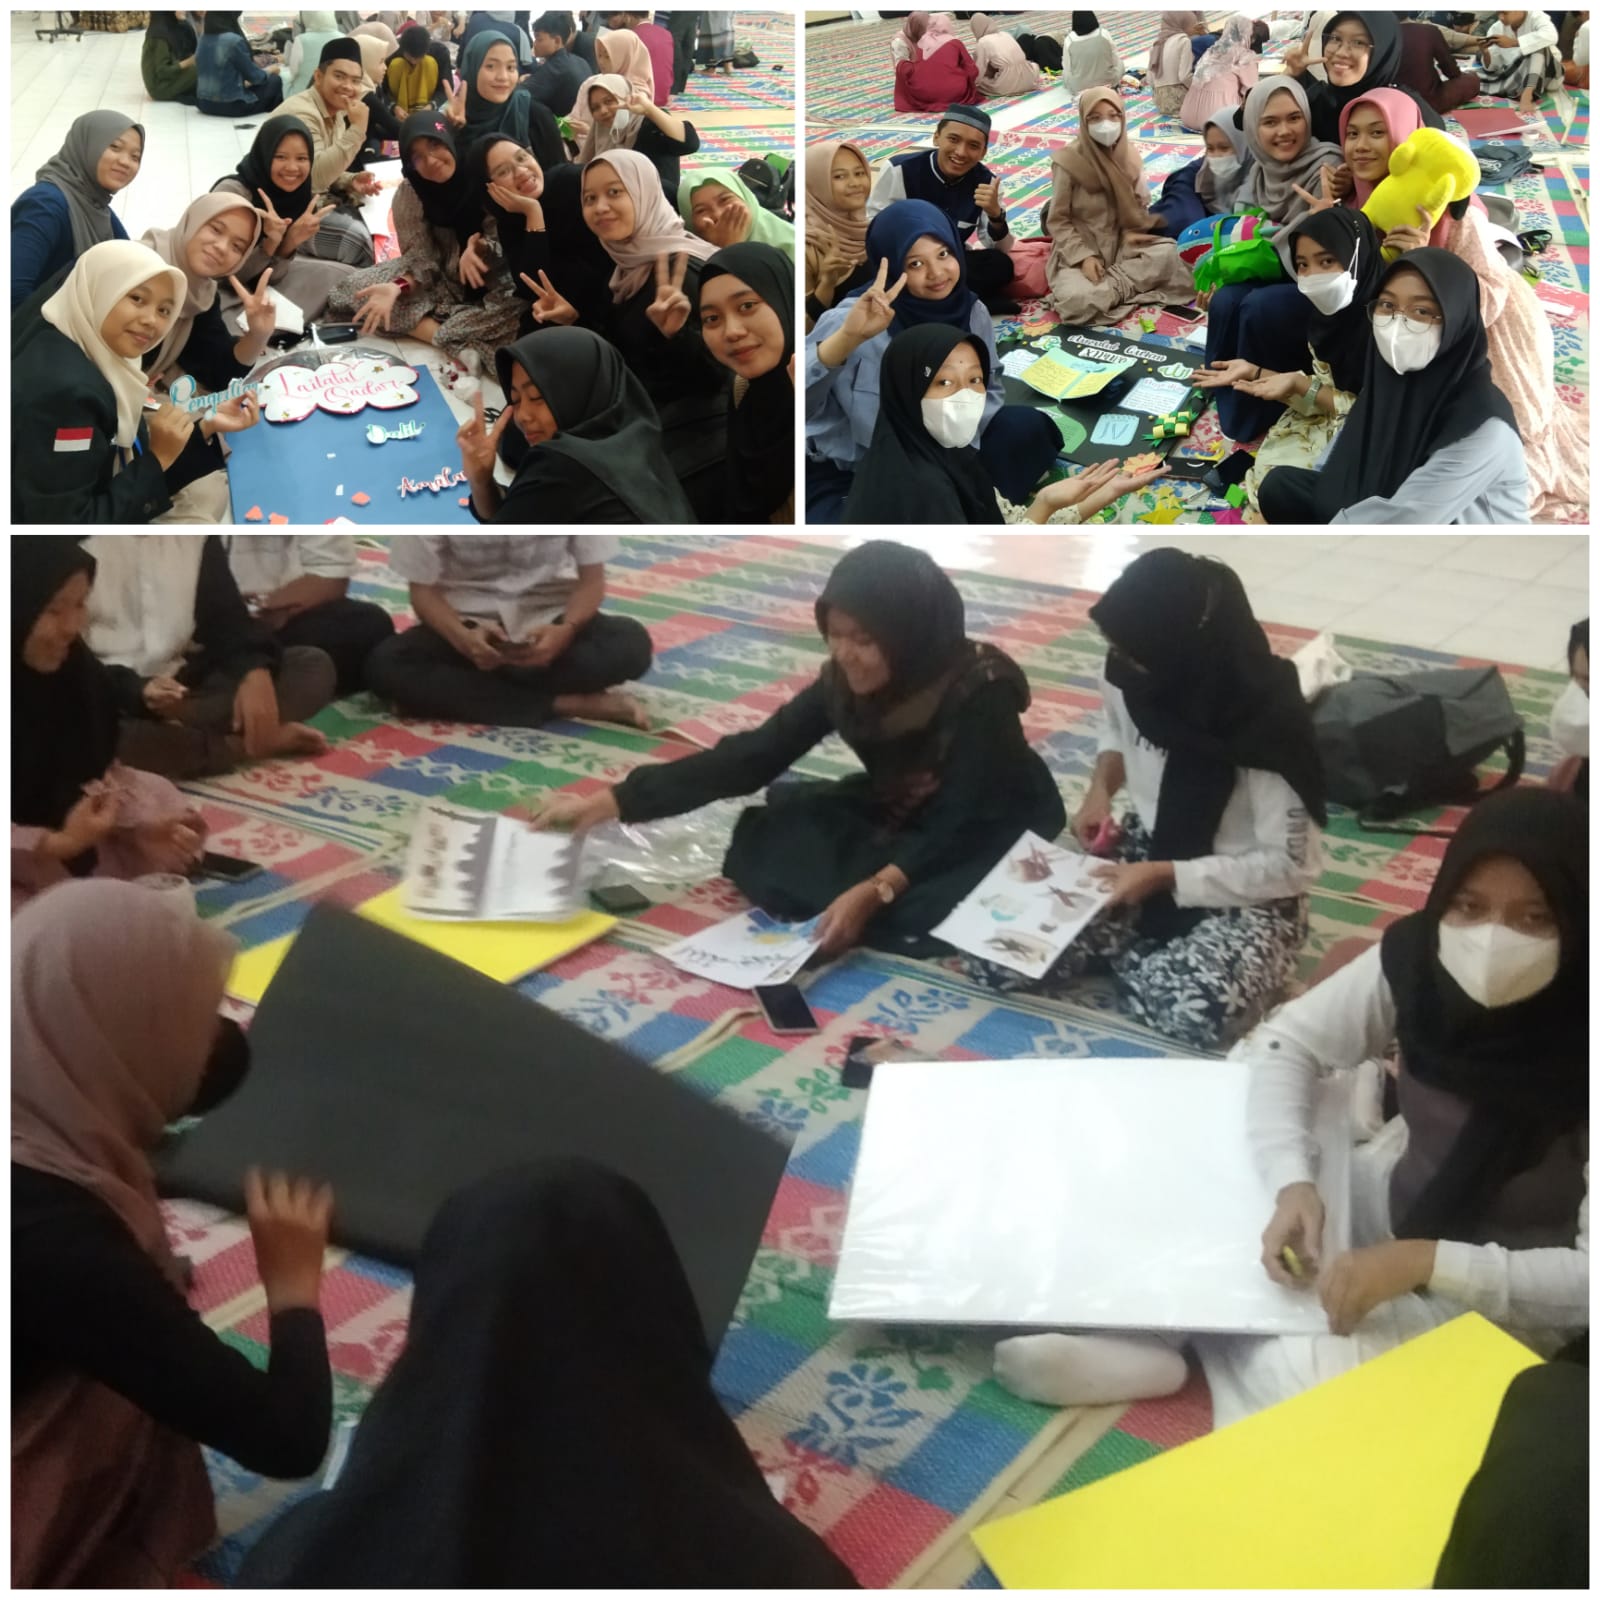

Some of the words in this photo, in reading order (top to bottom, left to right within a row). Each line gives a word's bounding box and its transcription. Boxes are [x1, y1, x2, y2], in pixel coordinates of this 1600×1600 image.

[279, 361, 362, 399] Lailatul
[323, 379, 404, 403] Qadar
[398, 467, 468, 497] Amala
